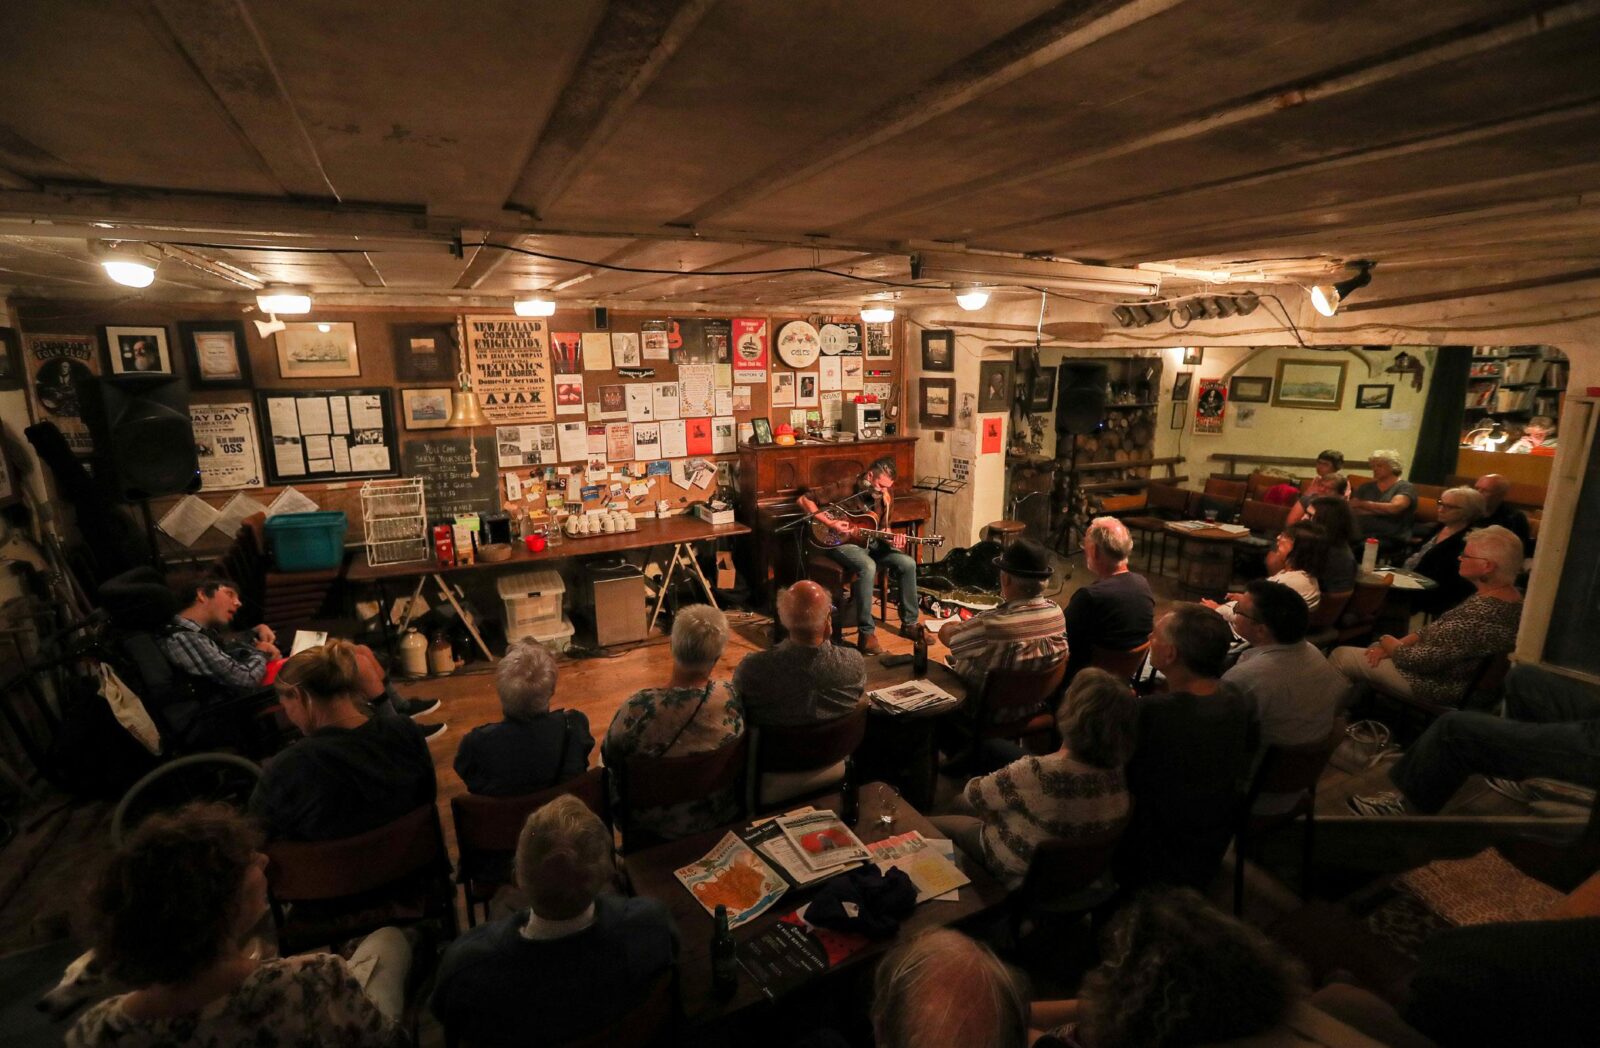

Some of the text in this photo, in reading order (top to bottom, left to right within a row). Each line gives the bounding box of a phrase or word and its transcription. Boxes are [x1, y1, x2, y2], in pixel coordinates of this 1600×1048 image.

[473, 322, 542, 332] NEW ZEALAND
[63, 348, 91, 360] CLUB
[486, 392, 541, 405] AJAX
